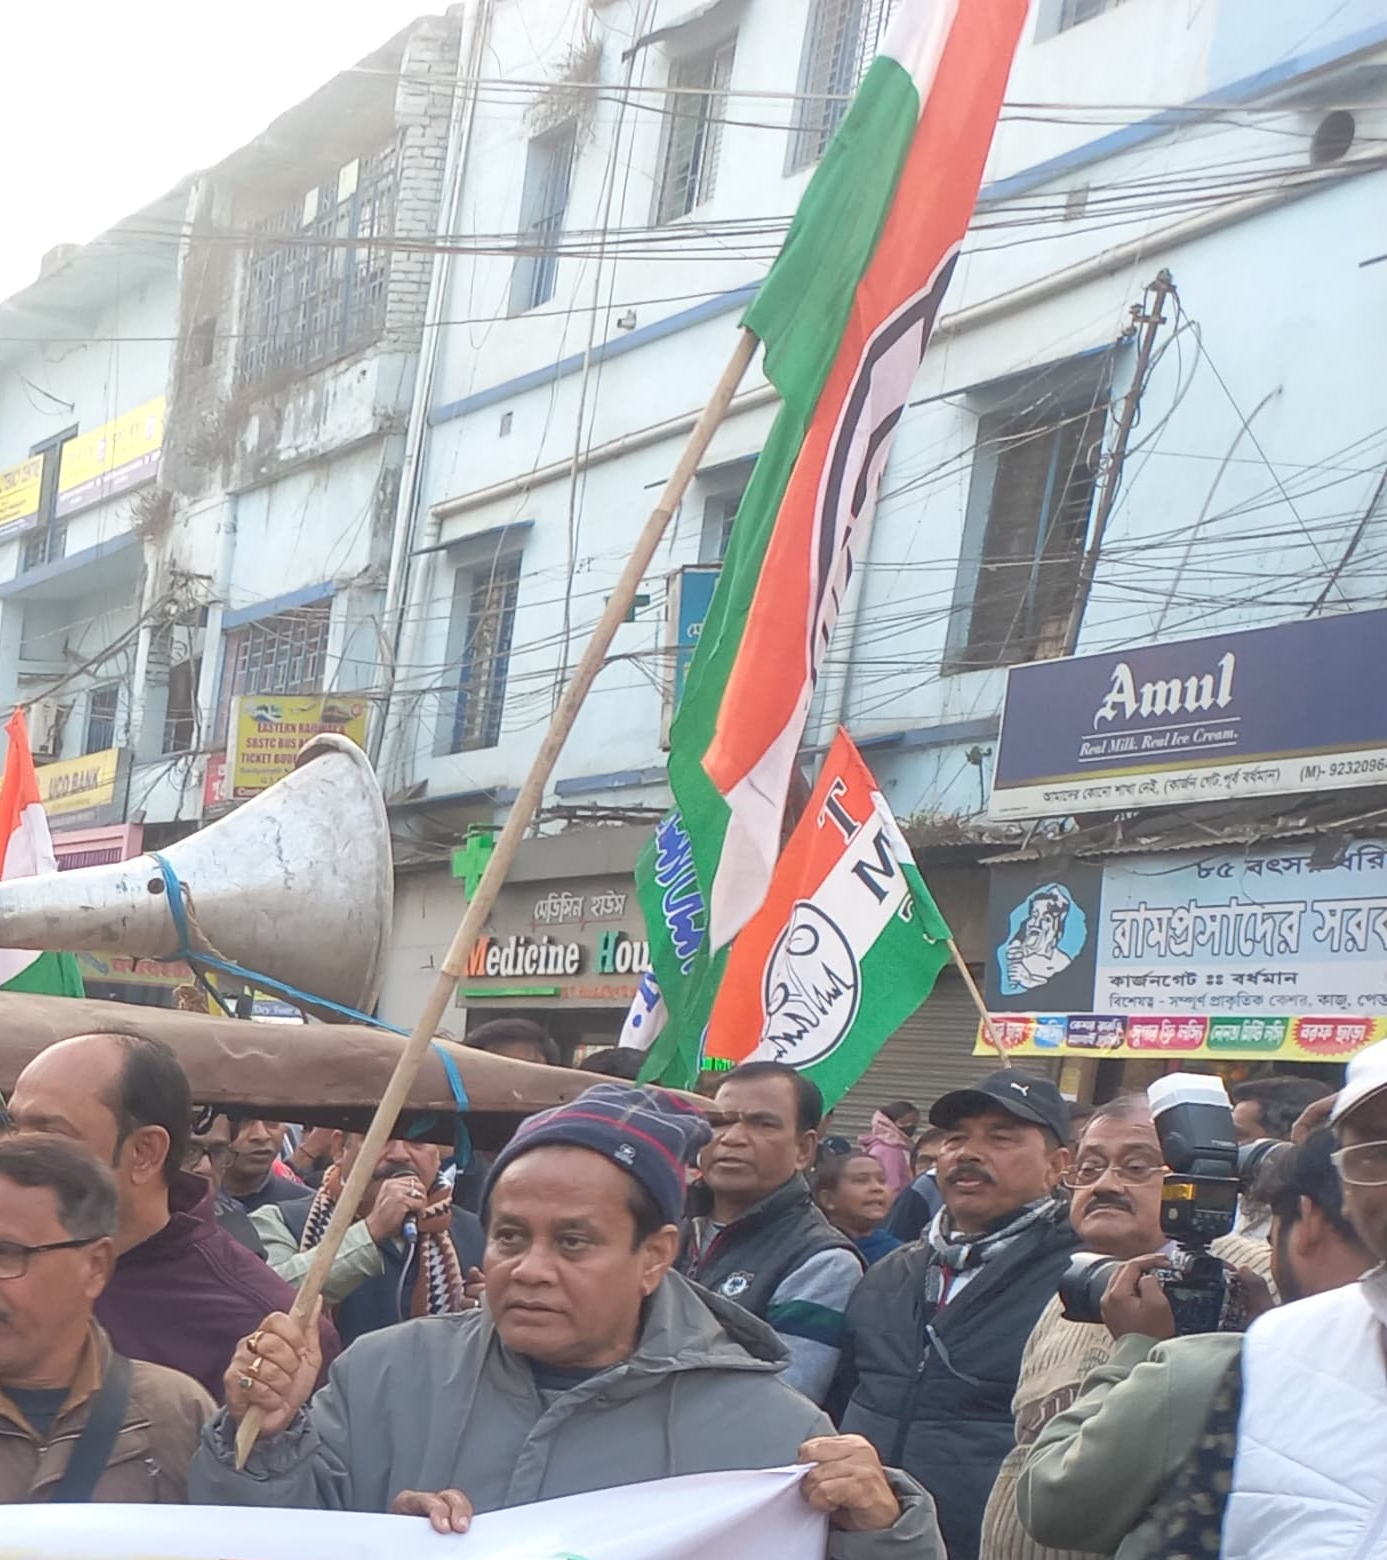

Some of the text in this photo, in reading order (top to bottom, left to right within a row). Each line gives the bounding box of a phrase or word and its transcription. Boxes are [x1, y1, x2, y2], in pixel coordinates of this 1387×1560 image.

[1093, 652, 1236, 731] Amul
[1079, 740, 1107, 757] Real
[1141, 732, 1171, 750] Real
[1171, 731, 1190, 746] Ice
[1193, 728, 1239, 744] Cream.
[241, 753, 271, 765] TICKET
[1197, 861, 1235, 879] ৮৫
[1244, 856, 1323, 877] বৎস
[533, 890, 628, 923] মেডিসিন হাউস
[1110, 896, 1307, 959] রামপ্রসাদের
[464, 931, 654, 977] Medicine Hou
[1109, 970, 1198, 987] কার্জনগেট
[1230, 968, 1300, 987] বর্ধমান
